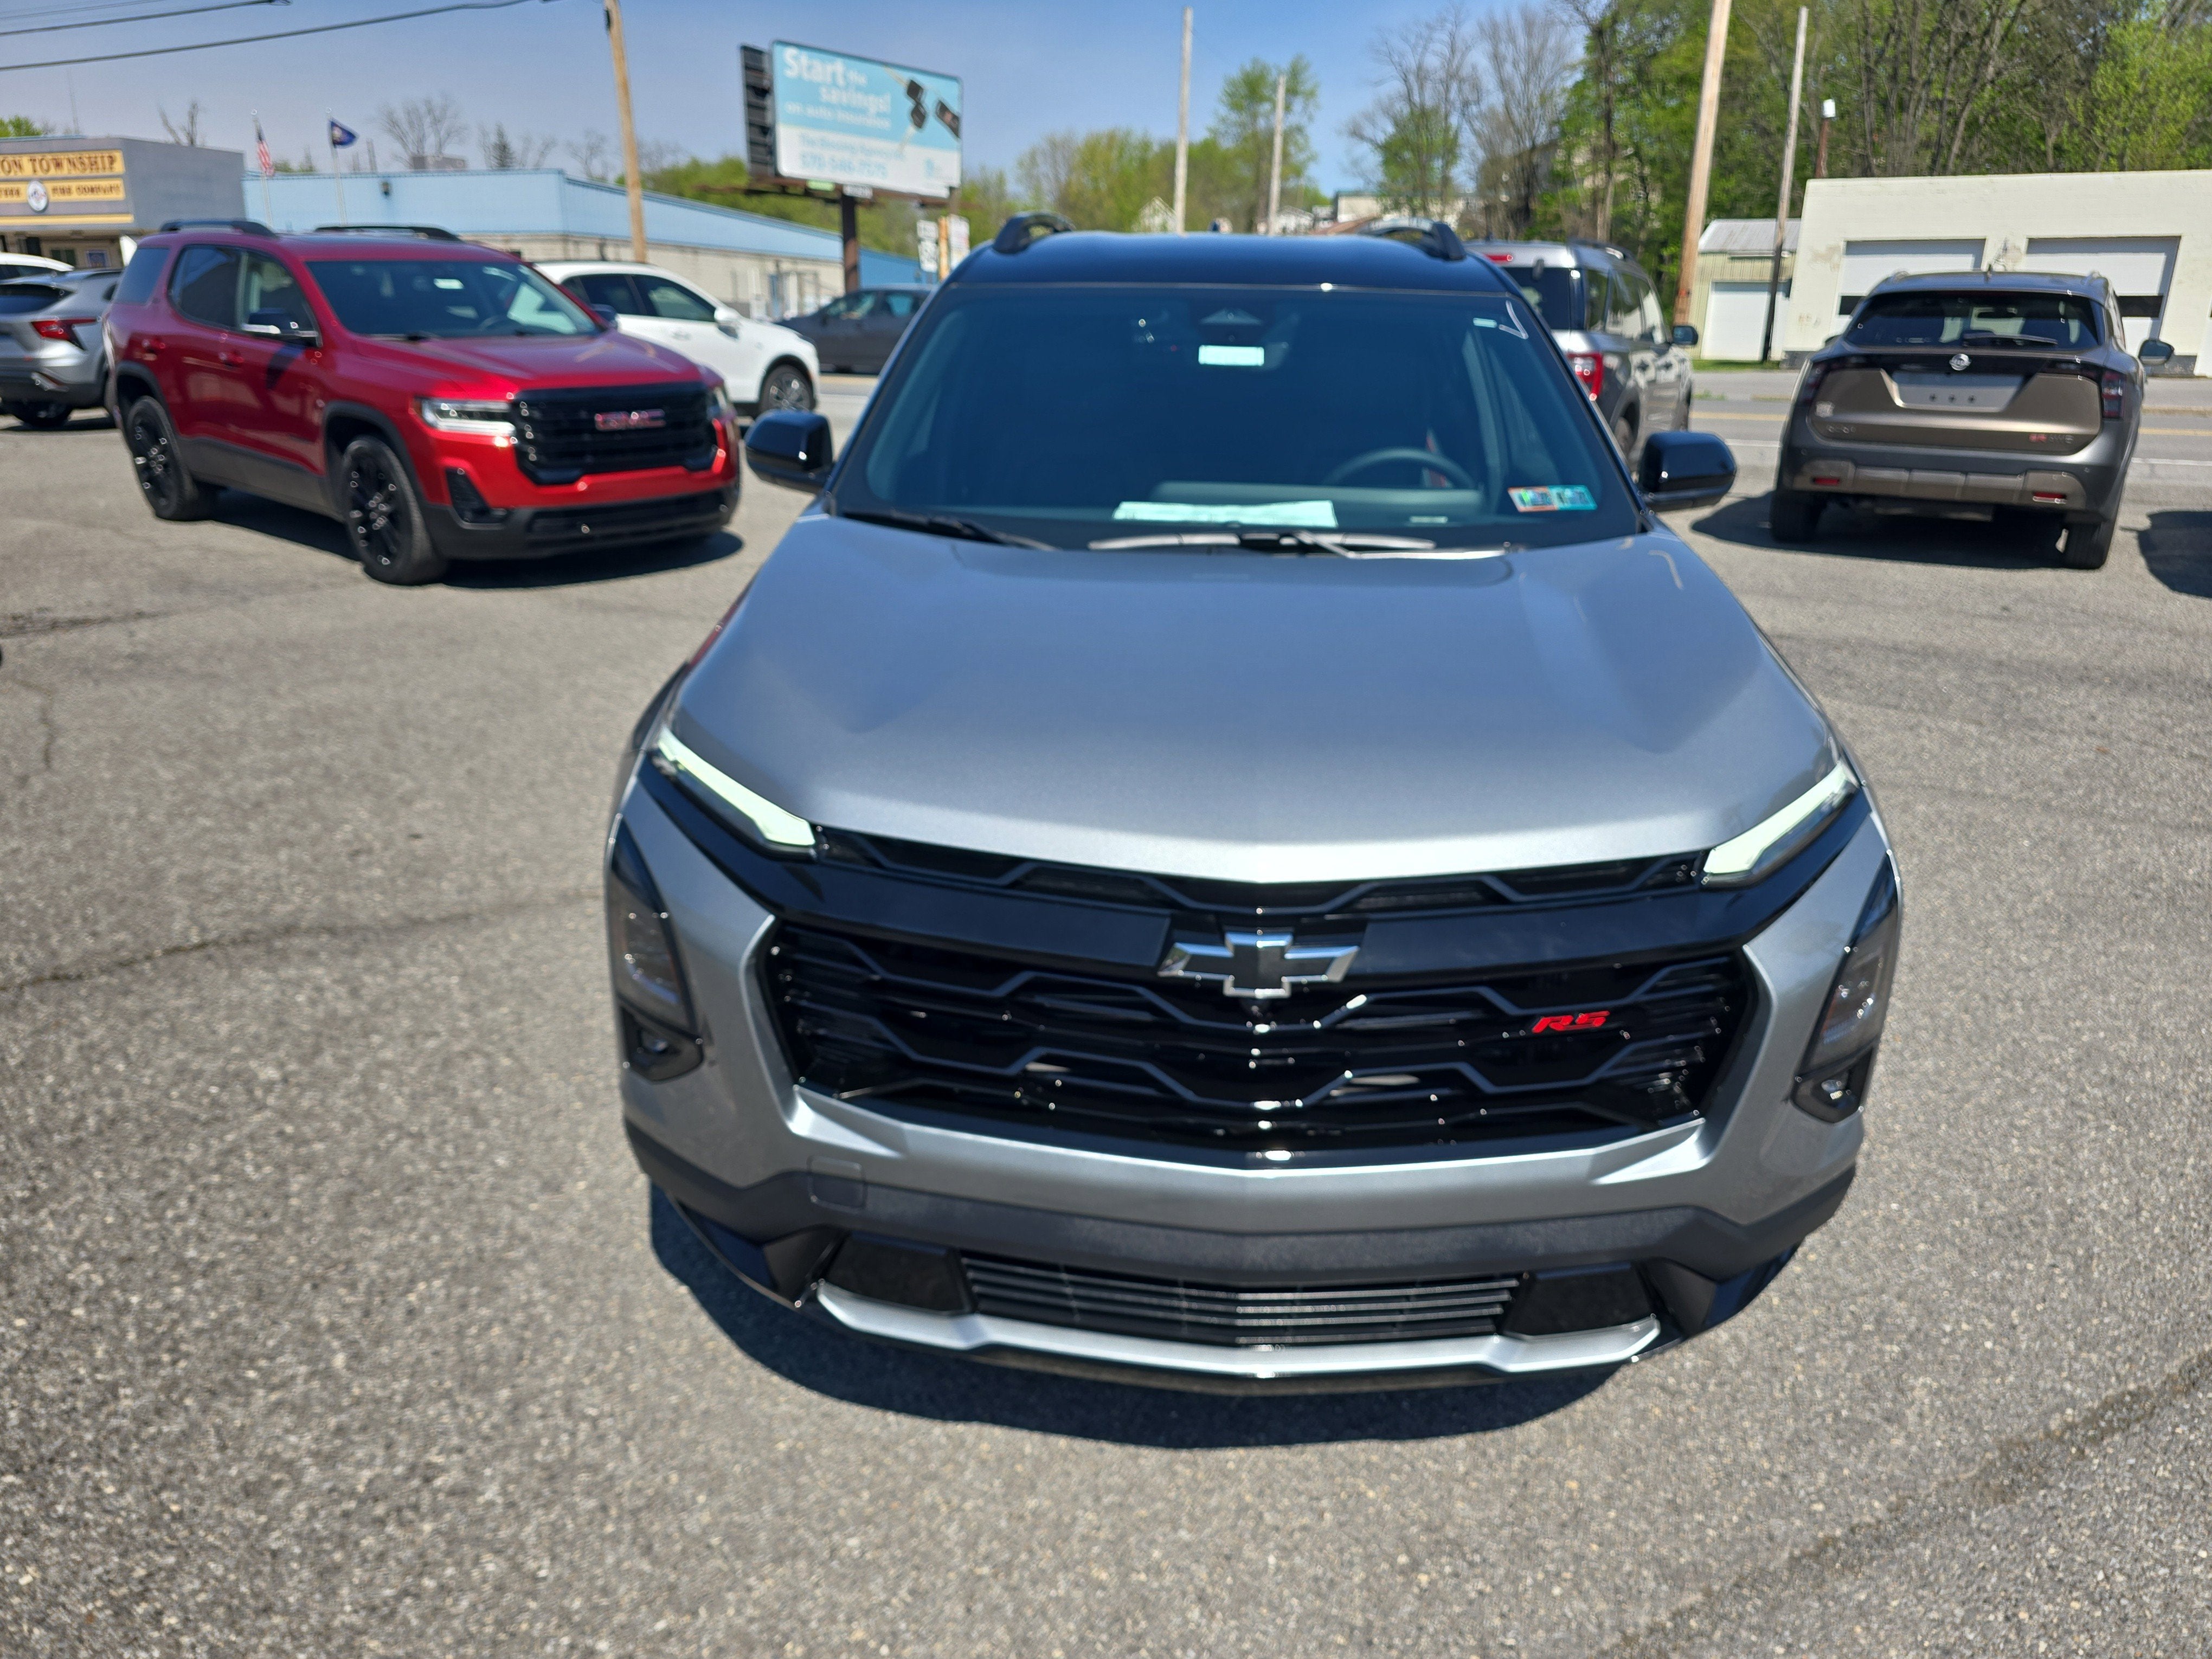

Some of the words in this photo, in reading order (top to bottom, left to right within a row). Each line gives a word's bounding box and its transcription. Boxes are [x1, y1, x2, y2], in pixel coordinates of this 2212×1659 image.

[783, 47, 846, 87] Start
[28, 155, 116, 174] TOWNSHIP
[595, 409, 666, 432] GMC
[1532, 1011, 1610, 1033] RS
